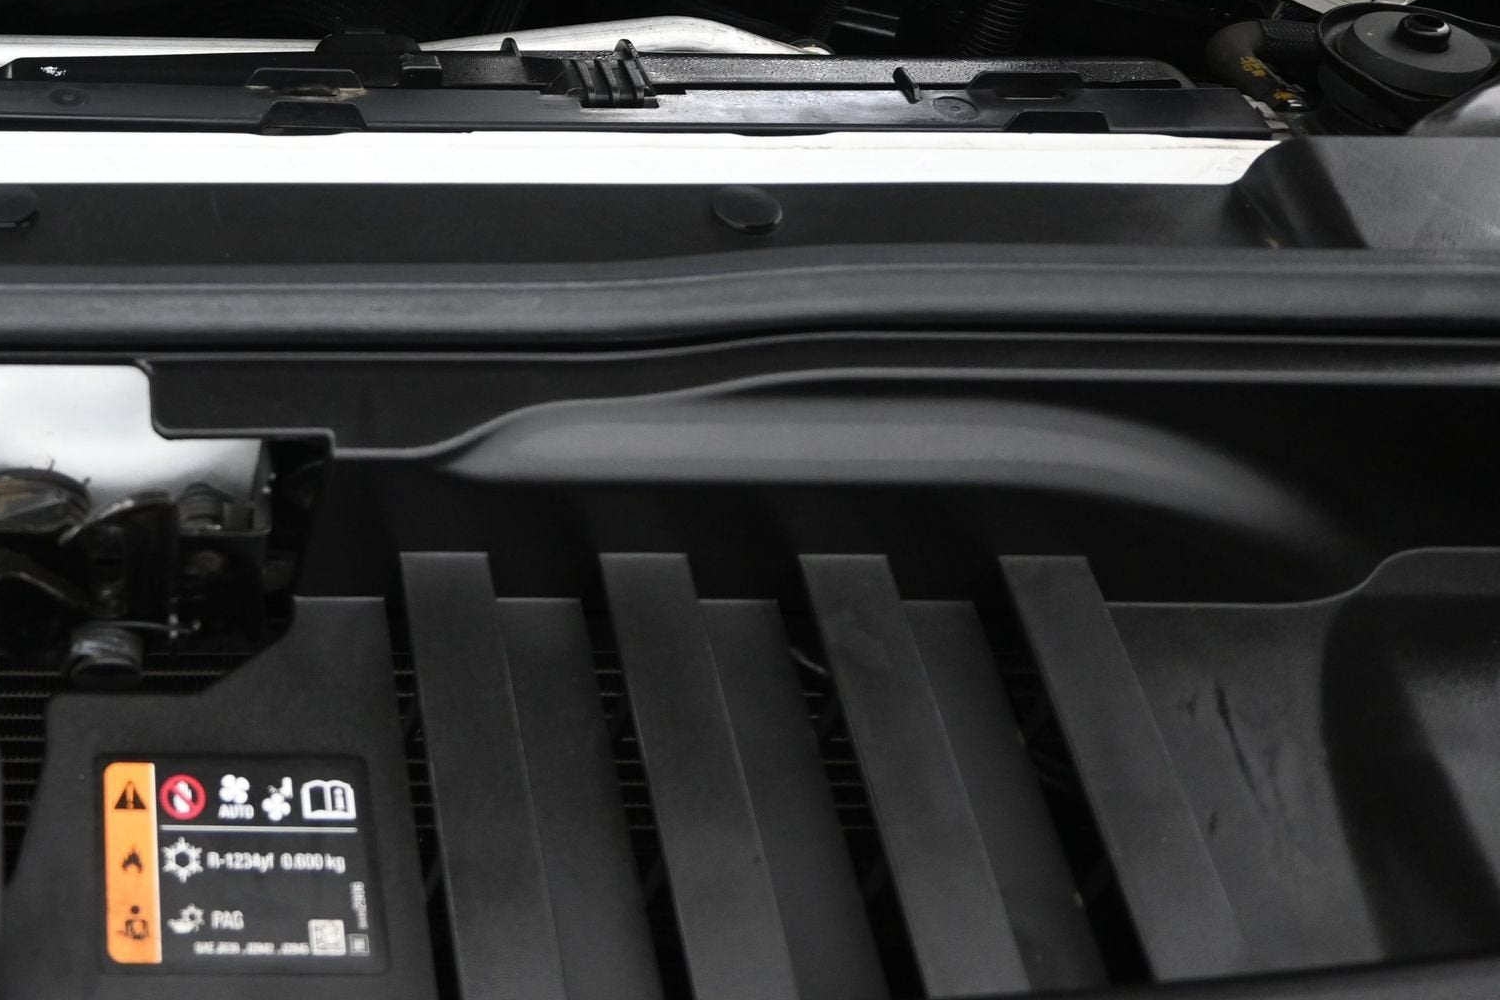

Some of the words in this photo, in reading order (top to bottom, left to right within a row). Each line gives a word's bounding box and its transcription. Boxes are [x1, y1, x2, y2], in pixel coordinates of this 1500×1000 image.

[218, 804, 254, 820] AUTO
[207, 852, 274, 873] R-1234yf
[325, 853, 346, 873] kg
[211, 910, 244, 930] PAG
